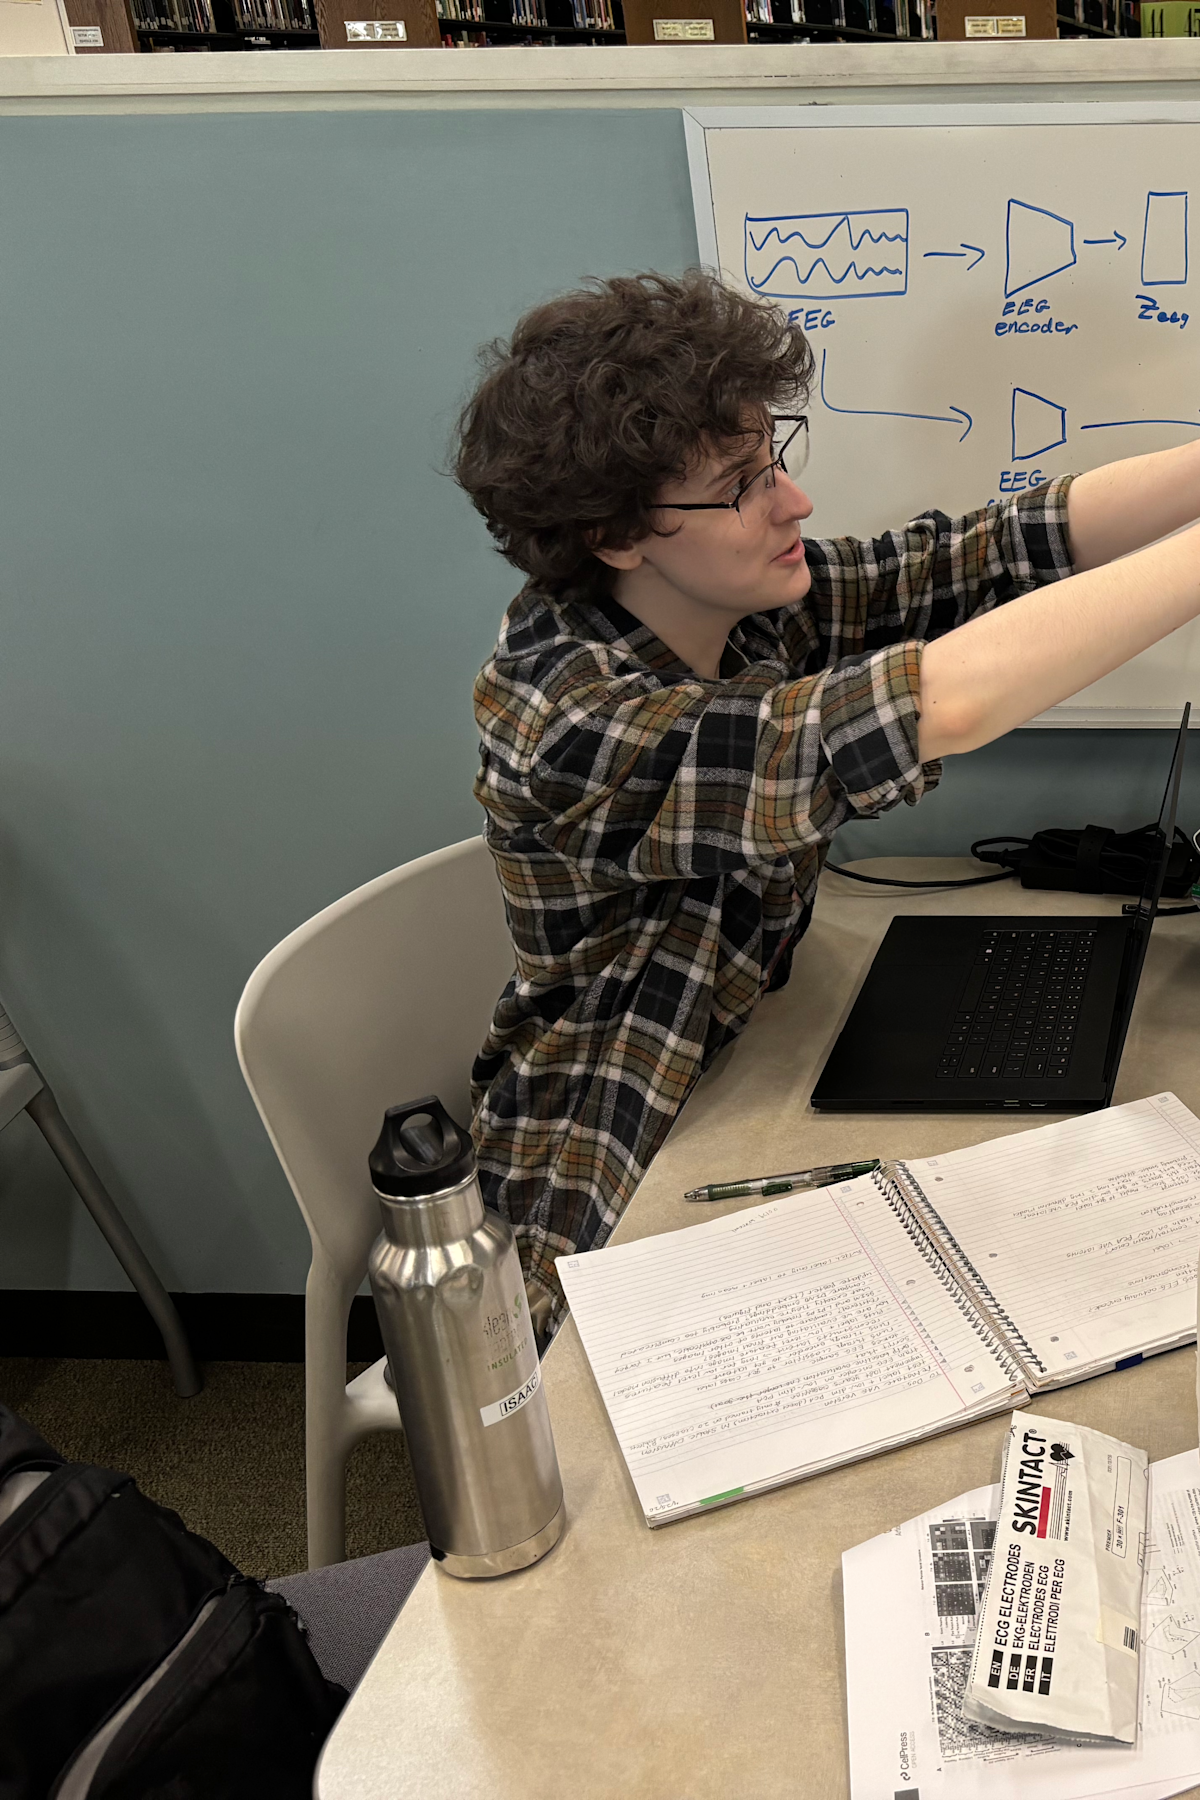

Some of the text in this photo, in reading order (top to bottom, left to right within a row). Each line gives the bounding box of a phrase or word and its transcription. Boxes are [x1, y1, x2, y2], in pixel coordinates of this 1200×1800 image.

[1002, 298, 1051, 317] EEG
[787, 308, 836, 331] EEG
[995, 317, 1079, 336] encoder
[999, 470, 1048, 491] EEG
[503, 1376, 538, 1412] ISAAC
[1062, 1490, 1073, 1541] www.skintact.com
[1115, 1505, 1124, 1524] F-301
[1115, 1538, 1123, 1549] 30
[995, 1544, 1021, 1646] ECG ELECTRODES
[1012, 1561, 1034, 1648] EKG-ELEKTRODEN
[1043, 1558, 1065, 1652] ELETTRODI PER ECG
[1028, 1565, 1049, 1650] ELECTRODES ECG
[990, 1660, 1003, 1676] EN
[1008, 1665, 1021, 1680] DE
[1024, 1667, 1036, 1682] FR
[1038, 1670, 1050, 1681] IT
